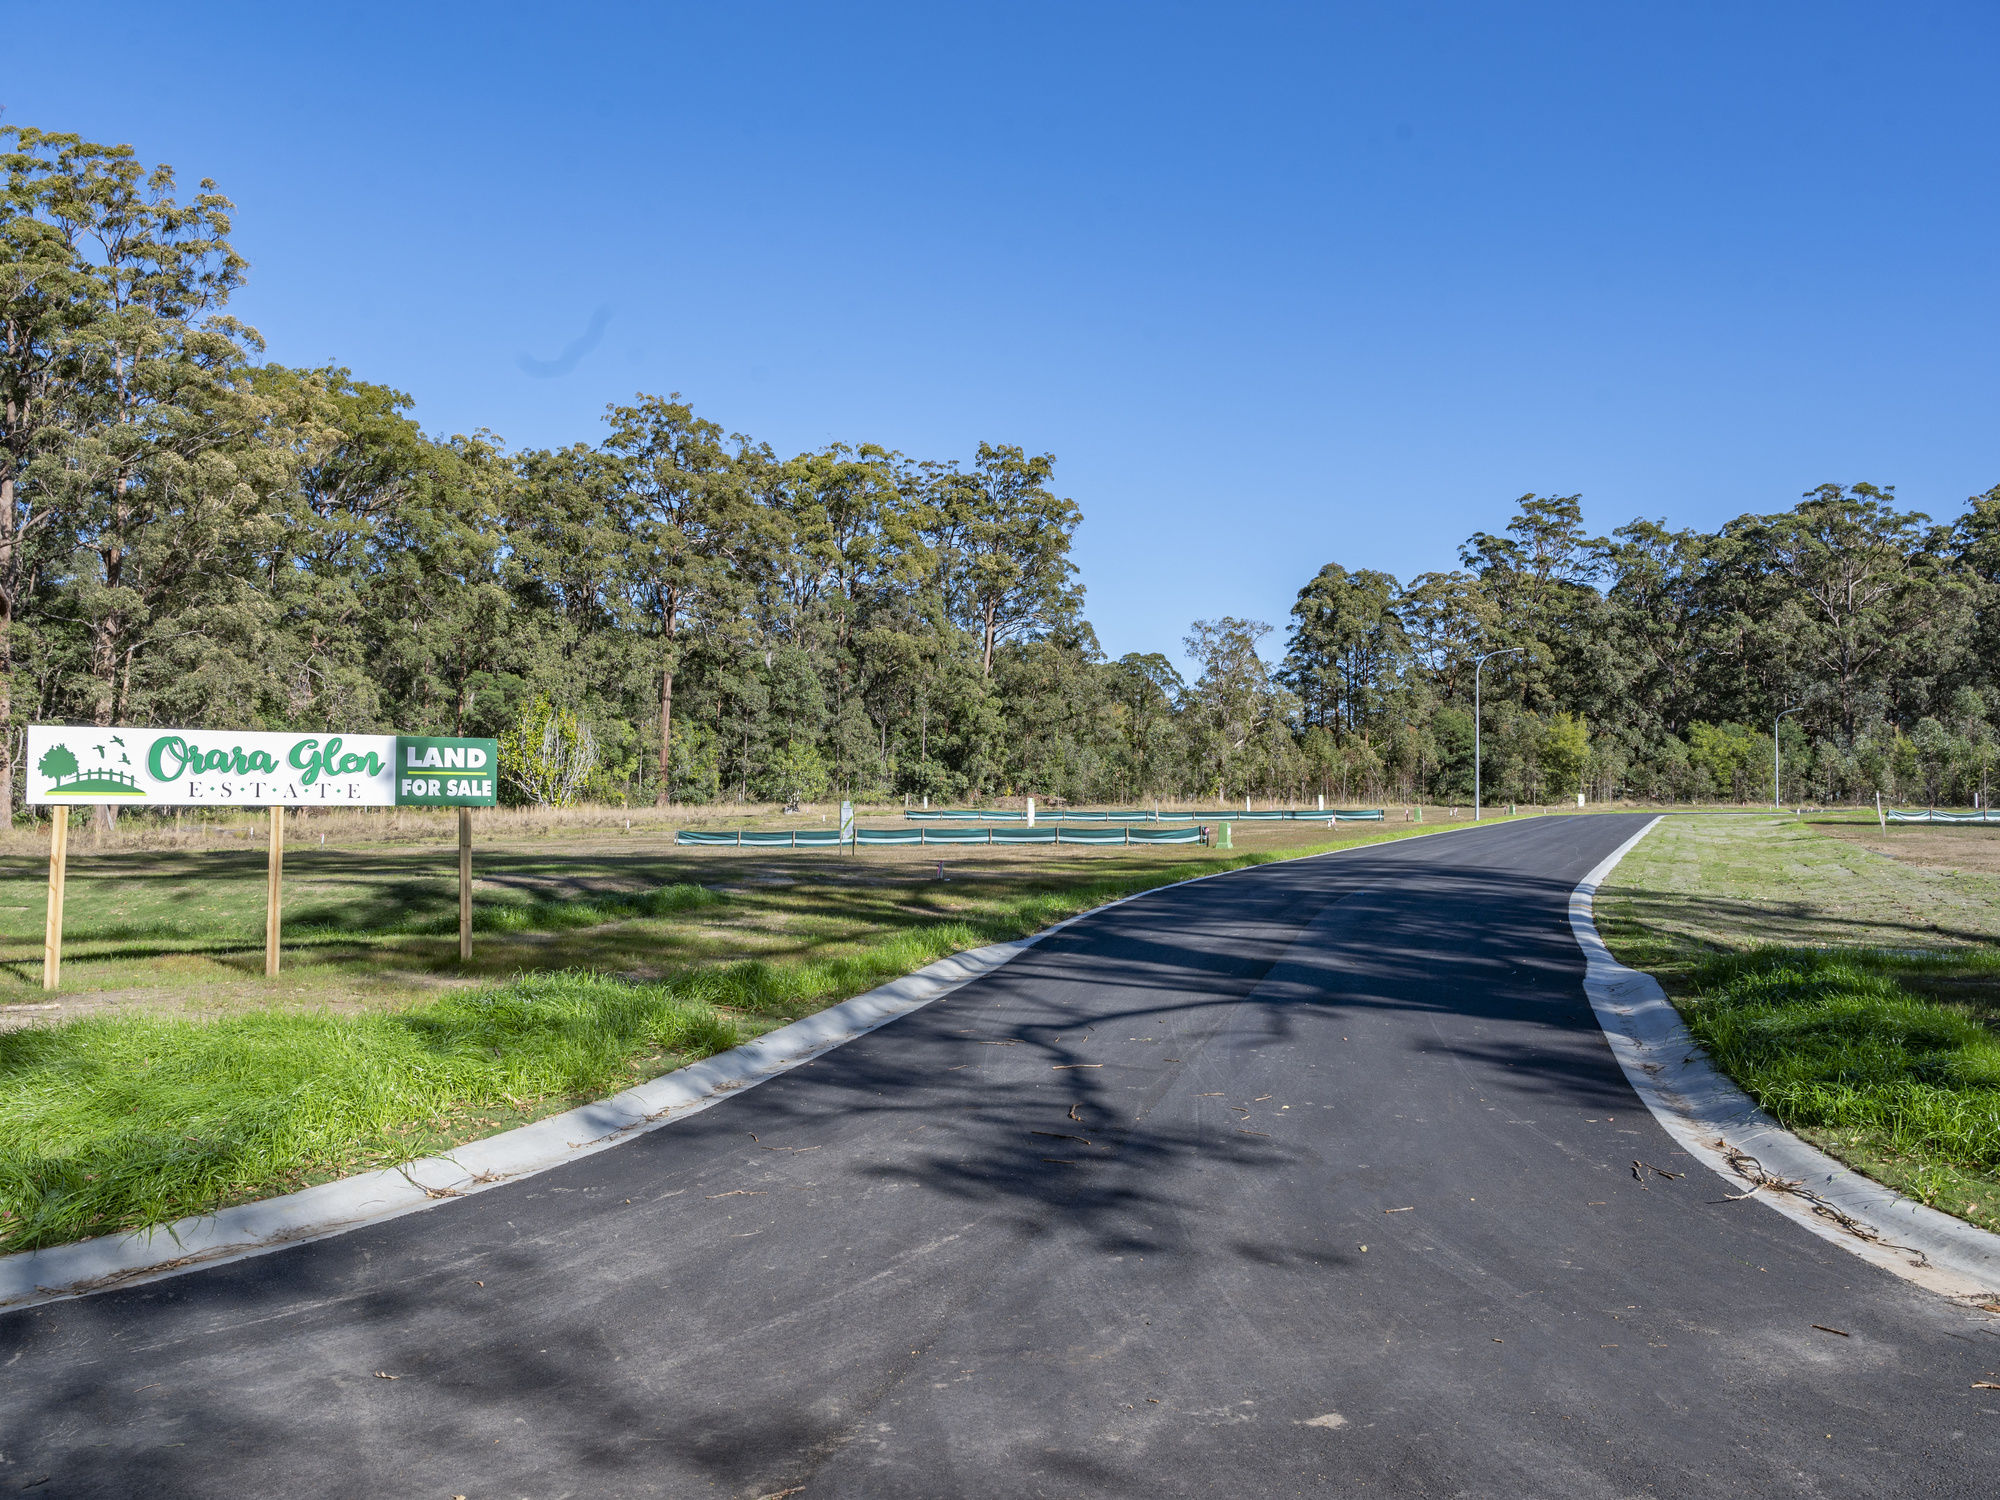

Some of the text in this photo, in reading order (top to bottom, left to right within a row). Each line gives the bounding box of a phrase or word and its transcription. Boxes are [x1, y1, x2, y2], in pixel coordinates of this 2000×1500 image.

[147, 736, 386, 786] Orara Glen
[407, 746, 487, 769] LAND
[401, 779, 492, 797] FOR SALE
